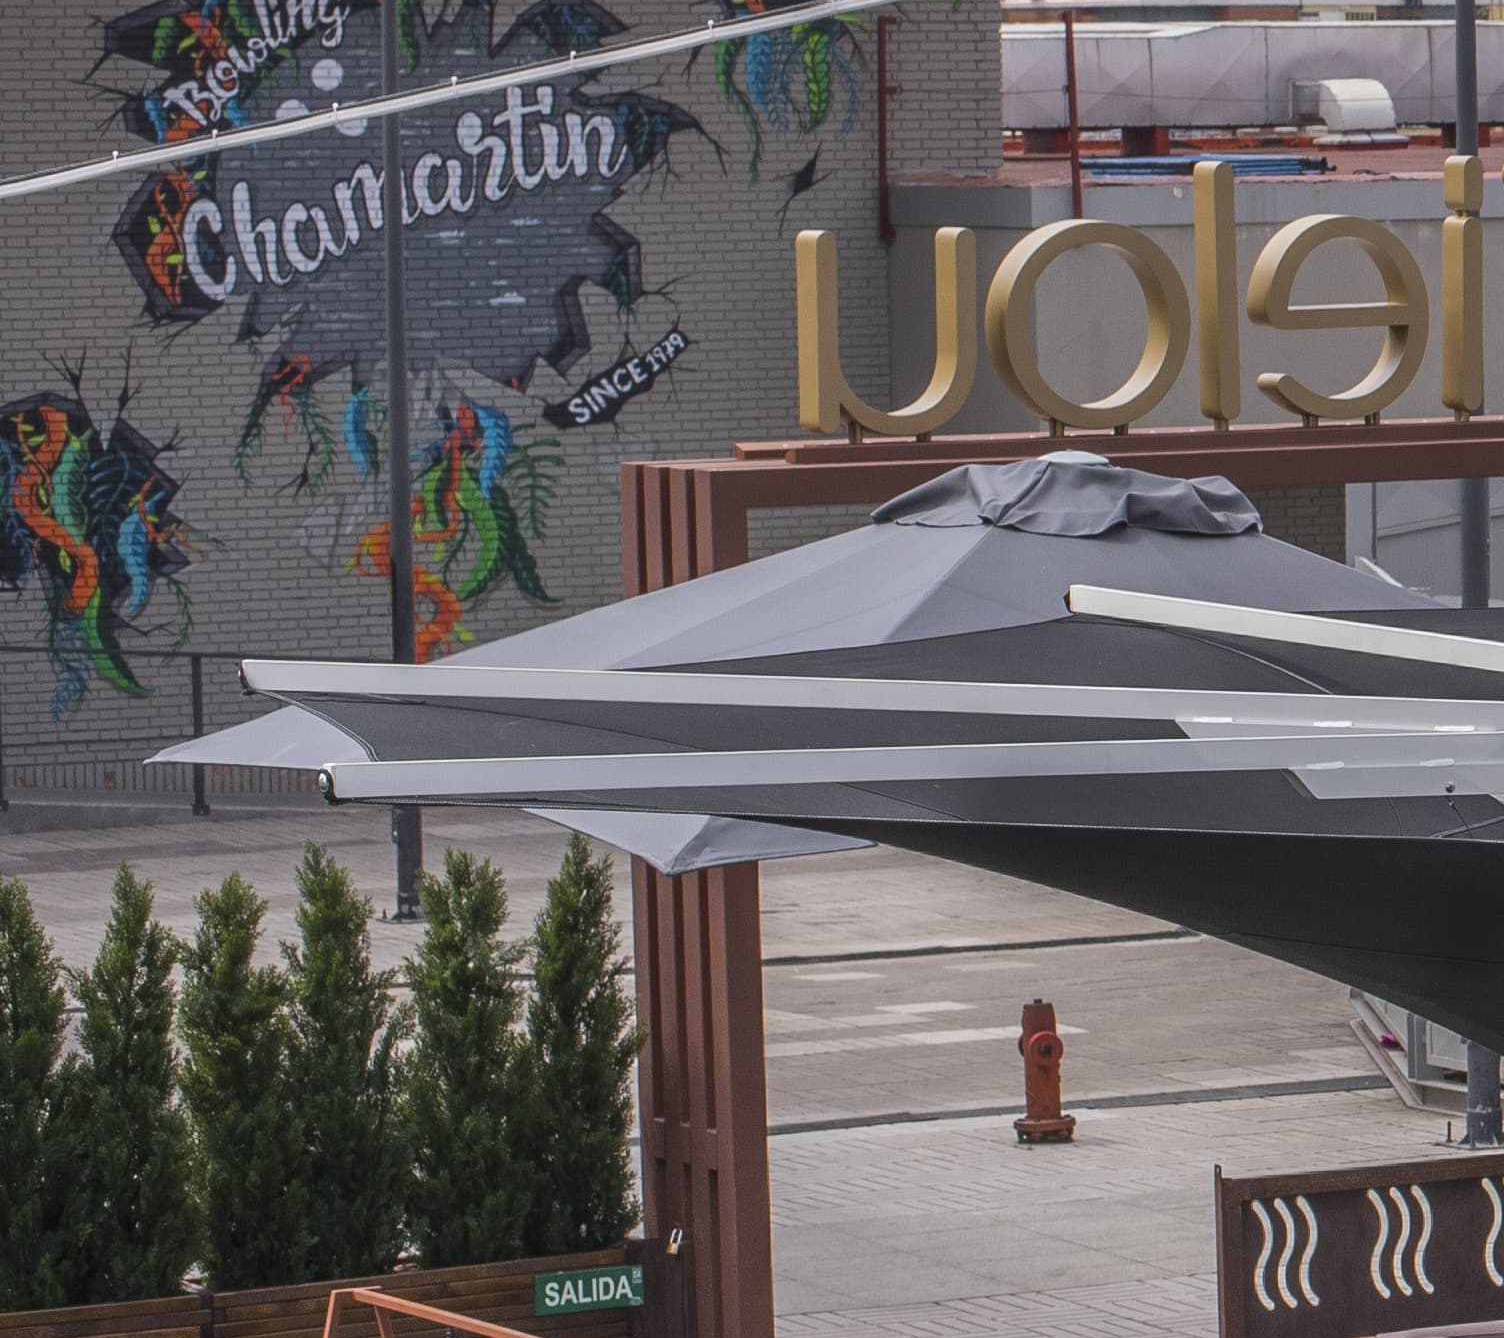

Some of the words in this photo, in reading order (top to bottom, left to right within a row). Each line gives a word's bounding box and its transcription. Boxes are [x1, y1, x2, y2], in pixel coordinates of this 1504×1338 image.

[182, 85, 630, 302] Chamartin
[567, 357, 648, 424] SINCE
[645, 332, 686, 372] 1979
[544, 1274, 633, 1307] SALIDA
